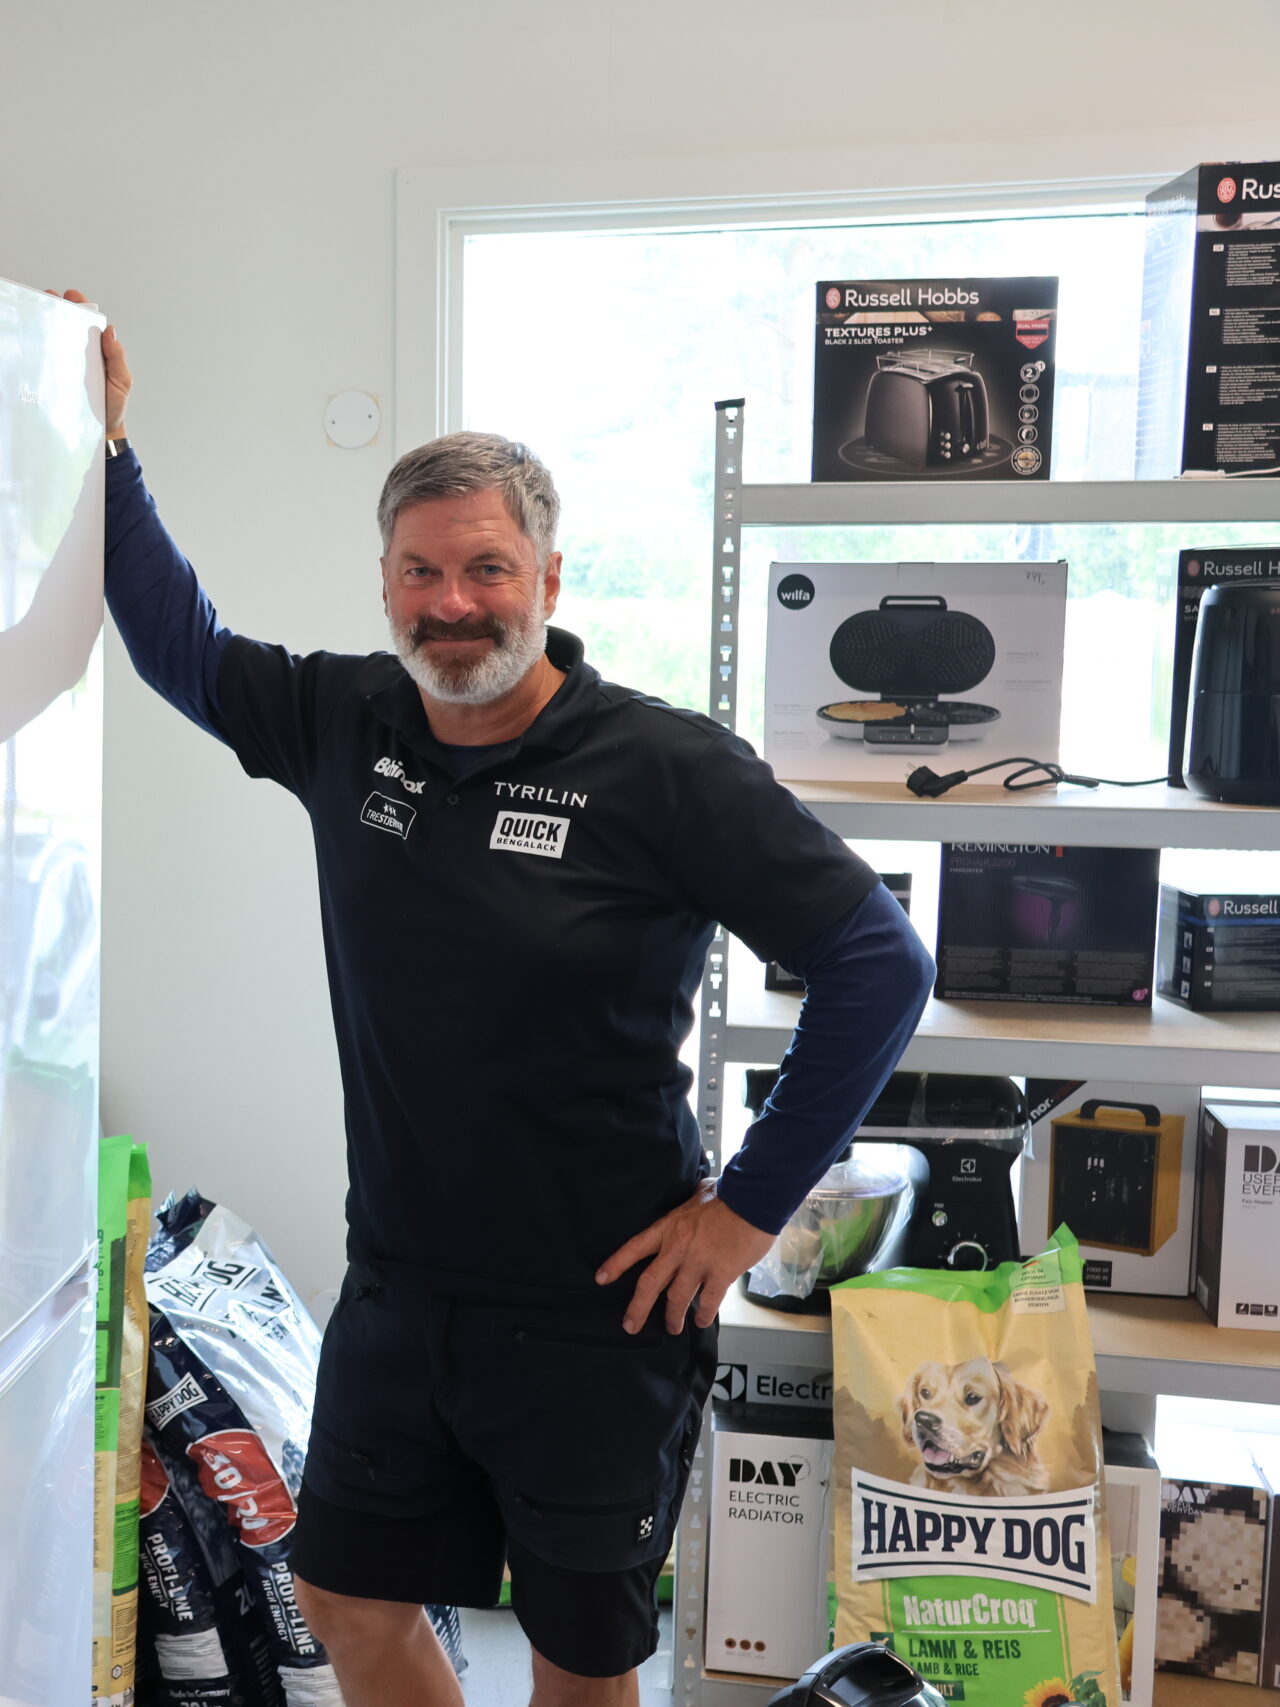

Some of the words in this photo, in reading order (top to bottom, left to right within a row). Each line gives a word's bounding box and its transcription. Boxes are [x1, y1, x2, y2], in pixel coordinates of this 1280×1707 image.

[845, 288, 911, 307] Russell
[918, 287, 980, 306] Hobbs
[825, 326, 891, 338] TEXTURES
[825, 337, 847, 345] BLACK
[848, 337, 853, 345] 2
[854, 337, 873, 345] SLICE
[873, 337, 904, 345] TOASTER
[1025, 368, 1035, 378] 2
[1204, 561, 1263, 576] Russell
[781, 588, 811, 601] wilfa
[494, 781, 588, 808] TYRILIN
[500, 817, 562, 843] QUICK
[496, 837, 557, 852] BENGALACK
[951, 842, 1050, 855] REMINGTON
[1223, 900, 1278, 915] Russell
[1243, 1145, 1280, 1174] D
[176, 1382, 200, 1405] DOG
[729, 1458, 804, 1488] DAY
[729, 1490, 800, 1507] ELECTRIC
[1161, 1484, 1211, 1504] DAY
[728, 1507, 804, 1525] RADIATOR
[861, 1497, 996, 1557] HAPPY
[1002, 1514, 1087, 1575] DOG
[140, 1553, 156, 1574] HIGH
[147, 1533, 193, 1622] PROFI-LINE
[262, 1580, 277, 1603] HIGH
[270, 1604, 290, 1642] ENERGY
[272, 1561, 315, 1655] PROFI-LINE
[903, 1593, 1036, 1628] NaturCroq
[908, 1639, 957, 1659] LAMM
[963, 1639, 978, 1659] &
[982, 1639, 1021, 1659] REIS
[944, 1662, 952, 1675] &
[955, 1663, 979, 1676] RICE
[194, 1688, 231, 1698] Germany
